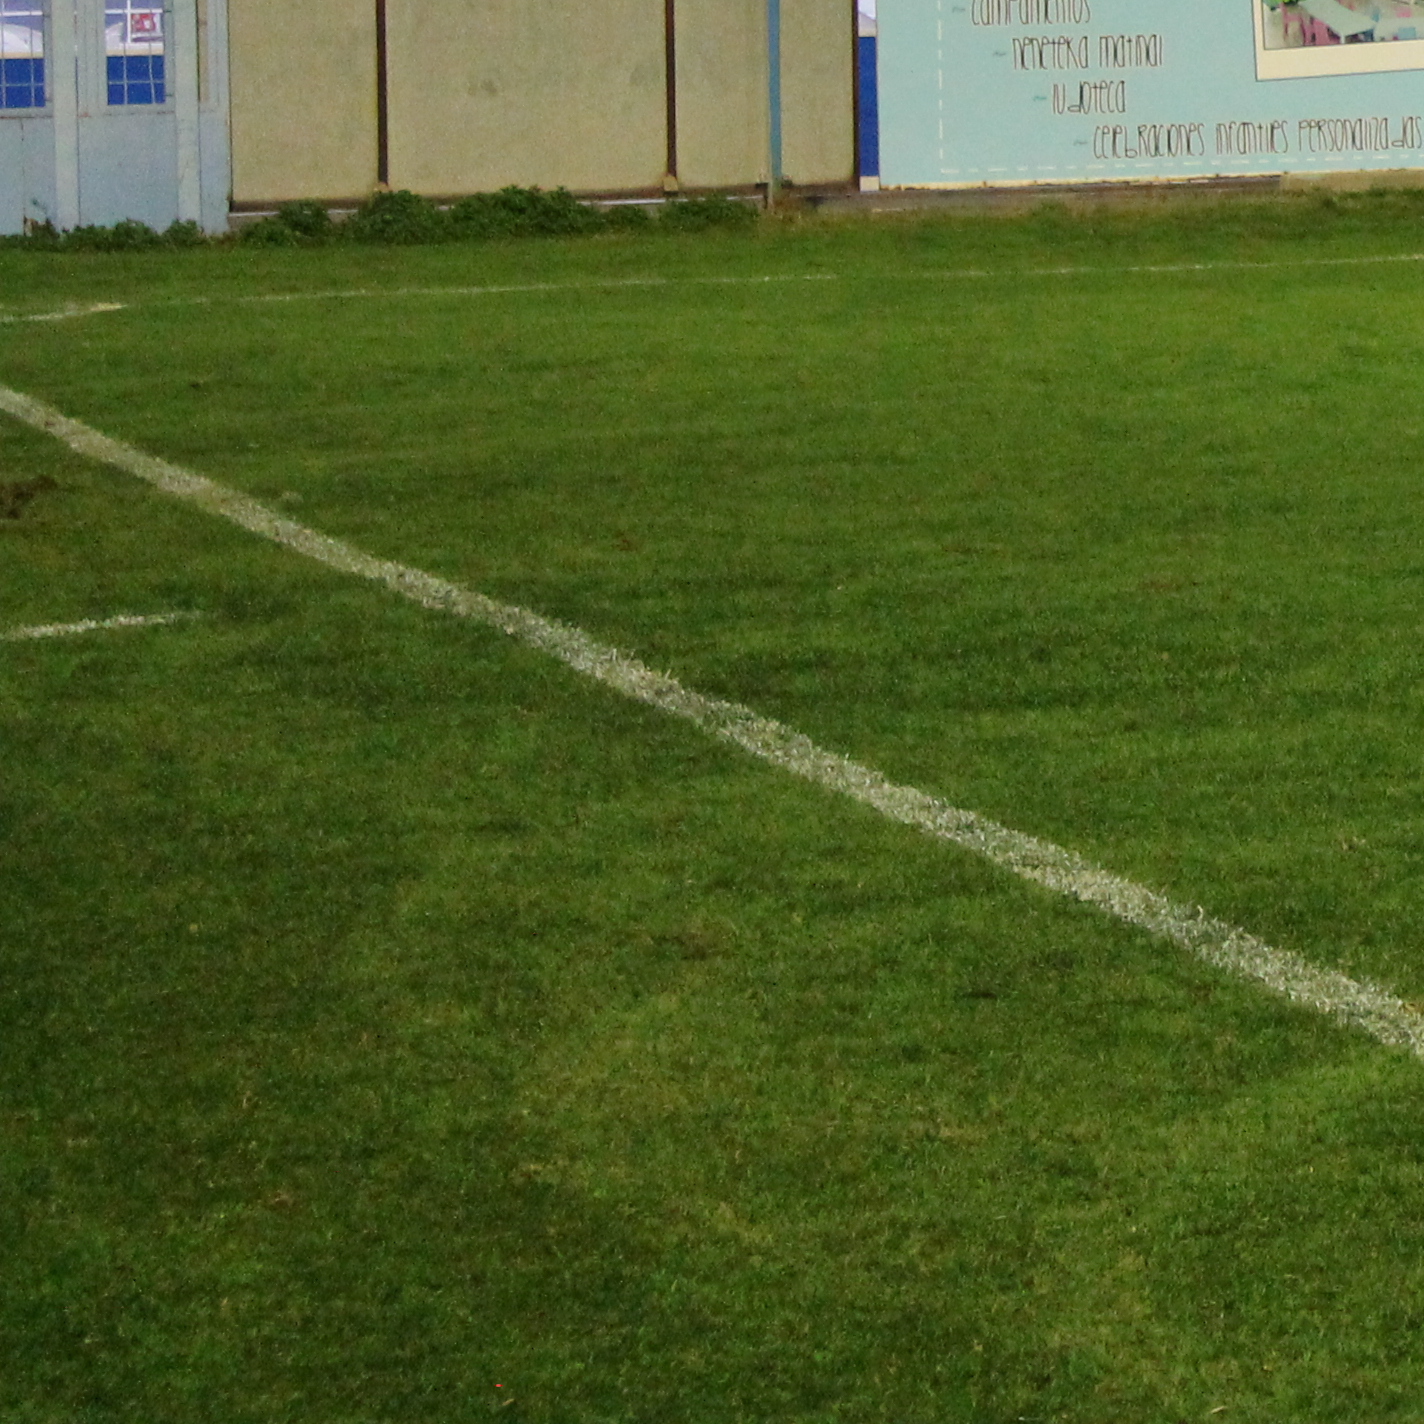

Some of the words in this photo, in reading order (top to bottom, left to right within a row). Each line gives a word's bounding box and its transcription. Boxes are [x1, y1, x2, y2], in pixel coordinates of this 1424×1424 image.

[1099, 33, 1164, 68] matinal
[1094, 122, 1206, 159] celebraciones
[1215, 119, 1289, 156] infantiles
